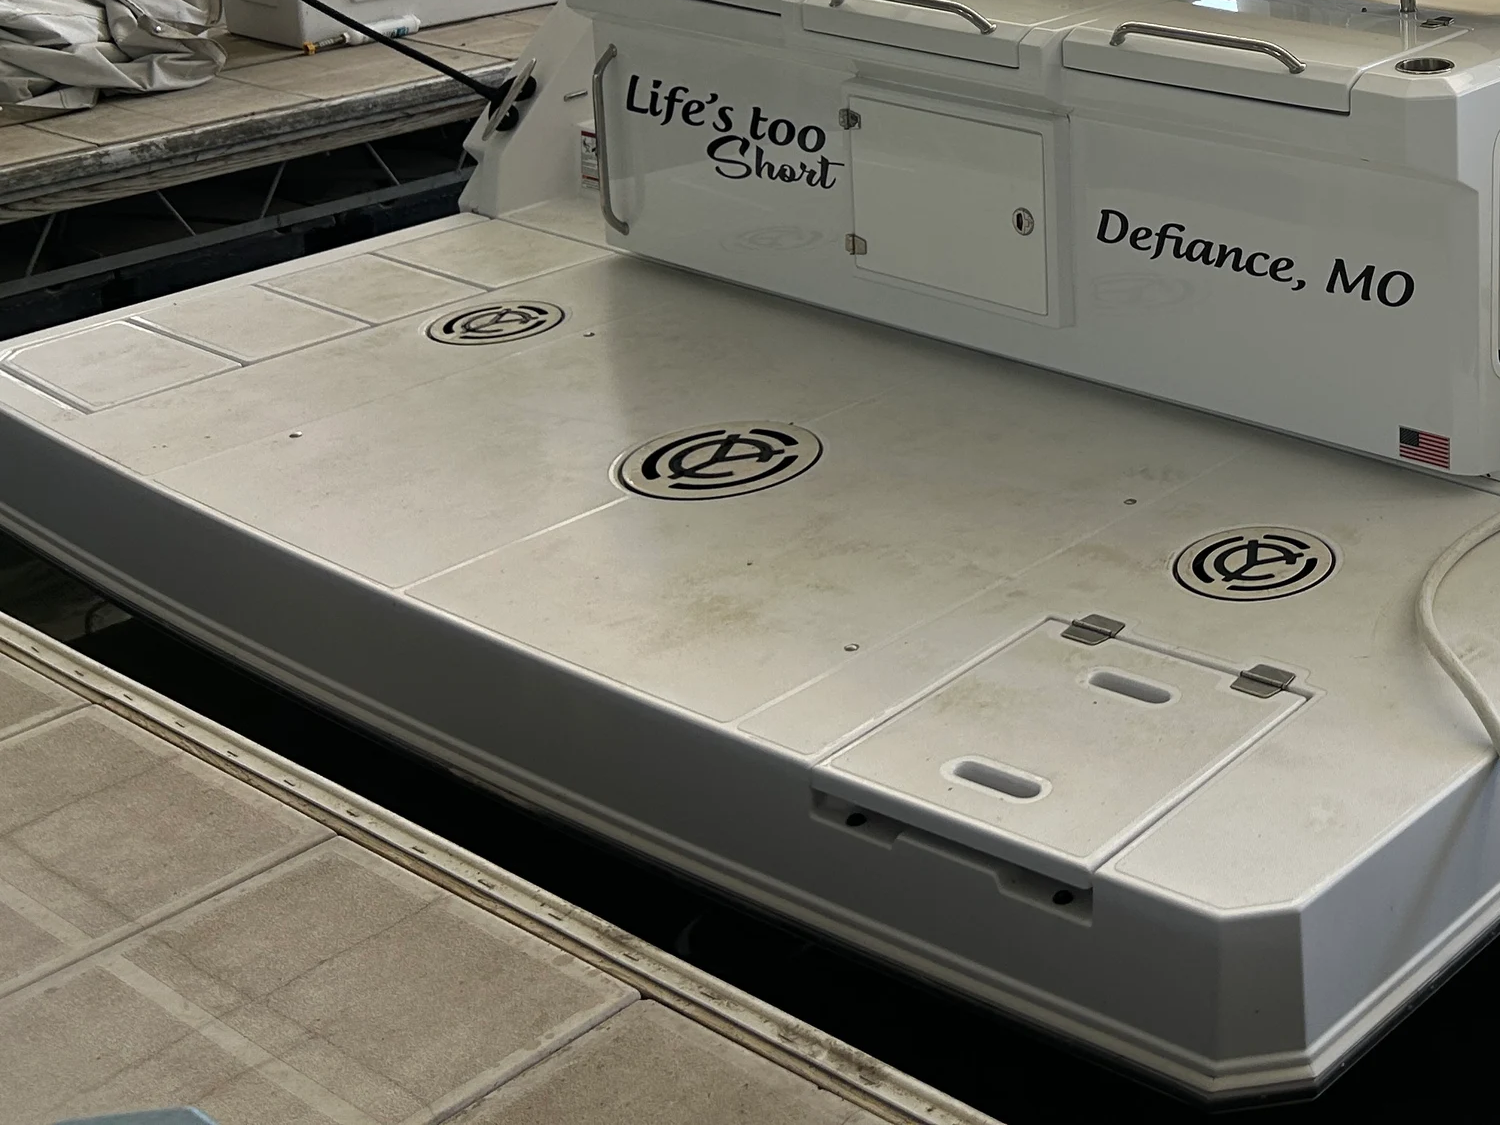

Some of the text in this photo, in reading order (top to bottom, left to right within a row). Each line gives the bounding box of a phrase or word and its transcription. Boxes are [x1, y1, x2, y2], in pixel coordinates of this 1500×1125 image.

[626, 74, 826, 153] Life's too
[706, 134, 845, 190] Short
[1096, 208, 1415, 307] Defiance, MO
